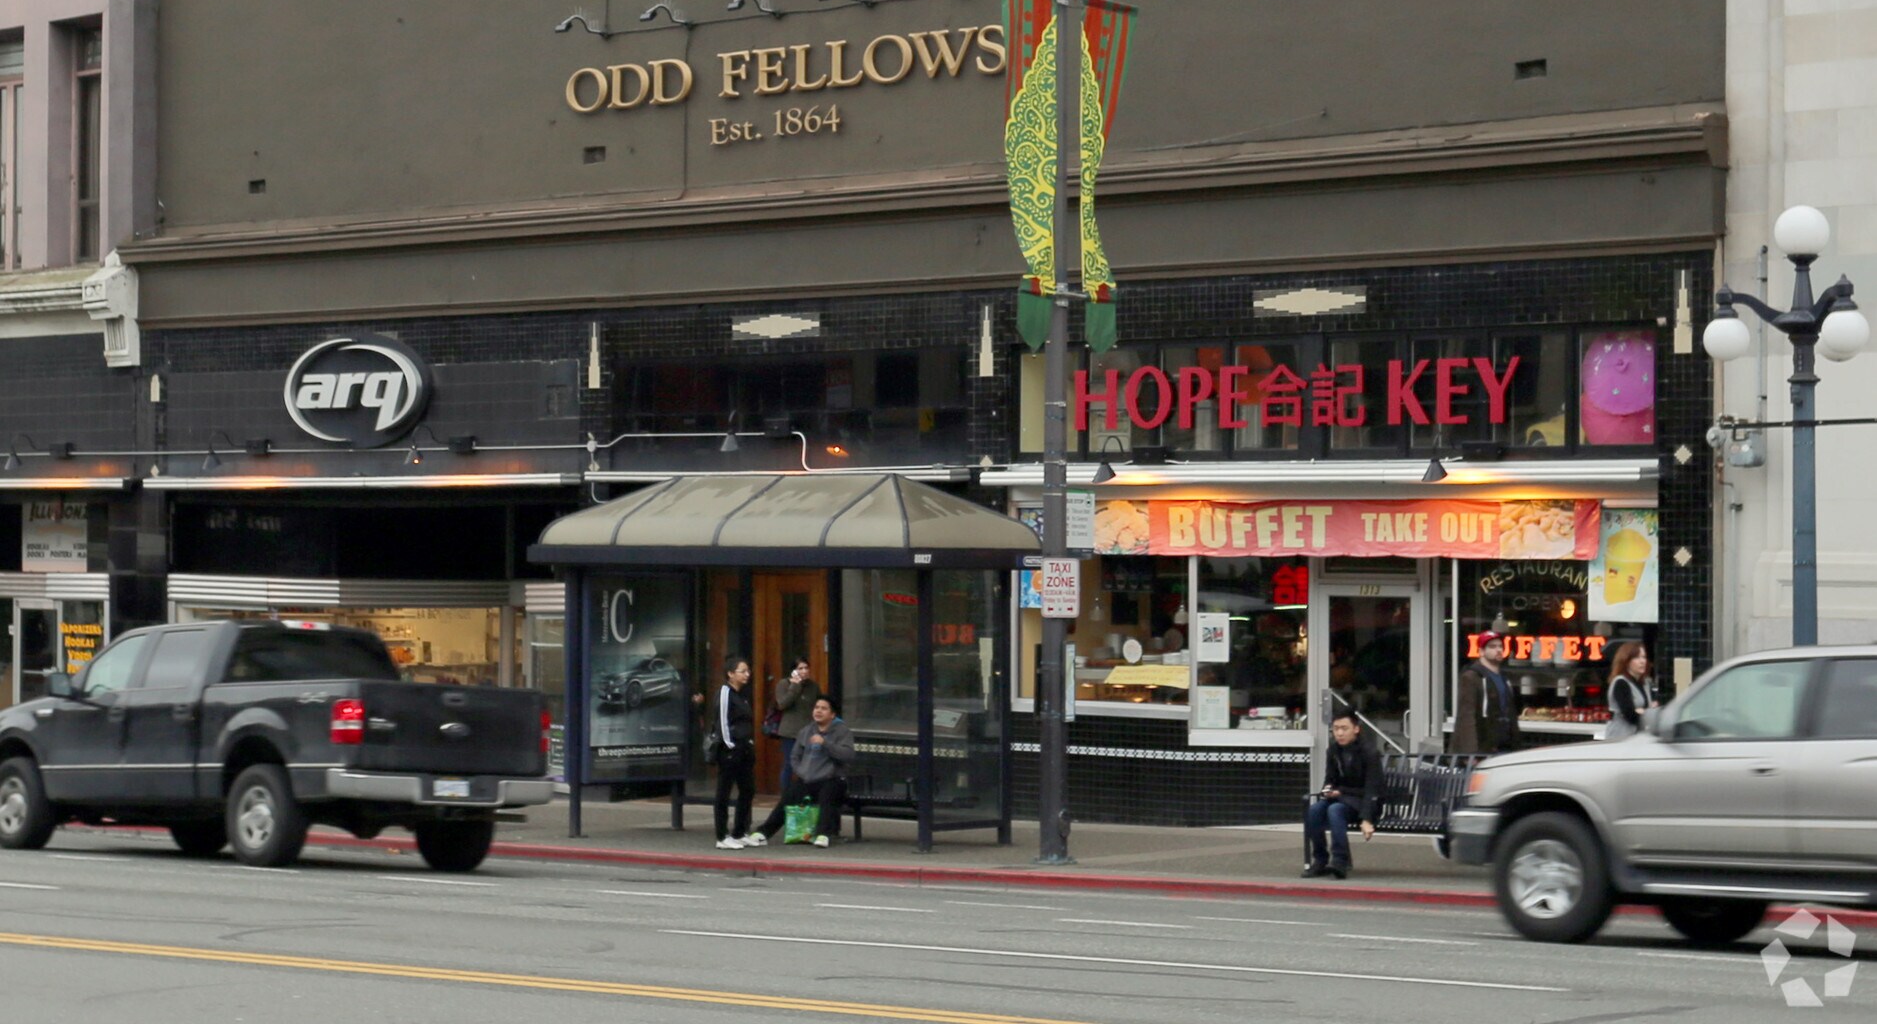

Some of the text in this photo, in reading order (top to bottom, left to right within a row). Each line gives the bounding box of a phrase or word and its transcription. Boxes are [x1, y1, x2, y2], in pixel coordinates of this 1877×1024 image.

[565, 24, 1006, 114] ODD FELLOWS
[709, 104, 840, 145] Est. 1864
[296, 371, 405, 432] arq
[1073, 355, 1521, 432] HOPE 合記 KEY
[1167, 505, 1496, 549] BUFFET TAKE OUT
[1046, 576, 1075, 587] ZONE
[1049, 562, 1072, 573] TAXI
[1479, 560, 1590, 596] RESTAURAN
[610, 589, 633, 643] C
[598, 746, 678, 758] threepointmotors.com
